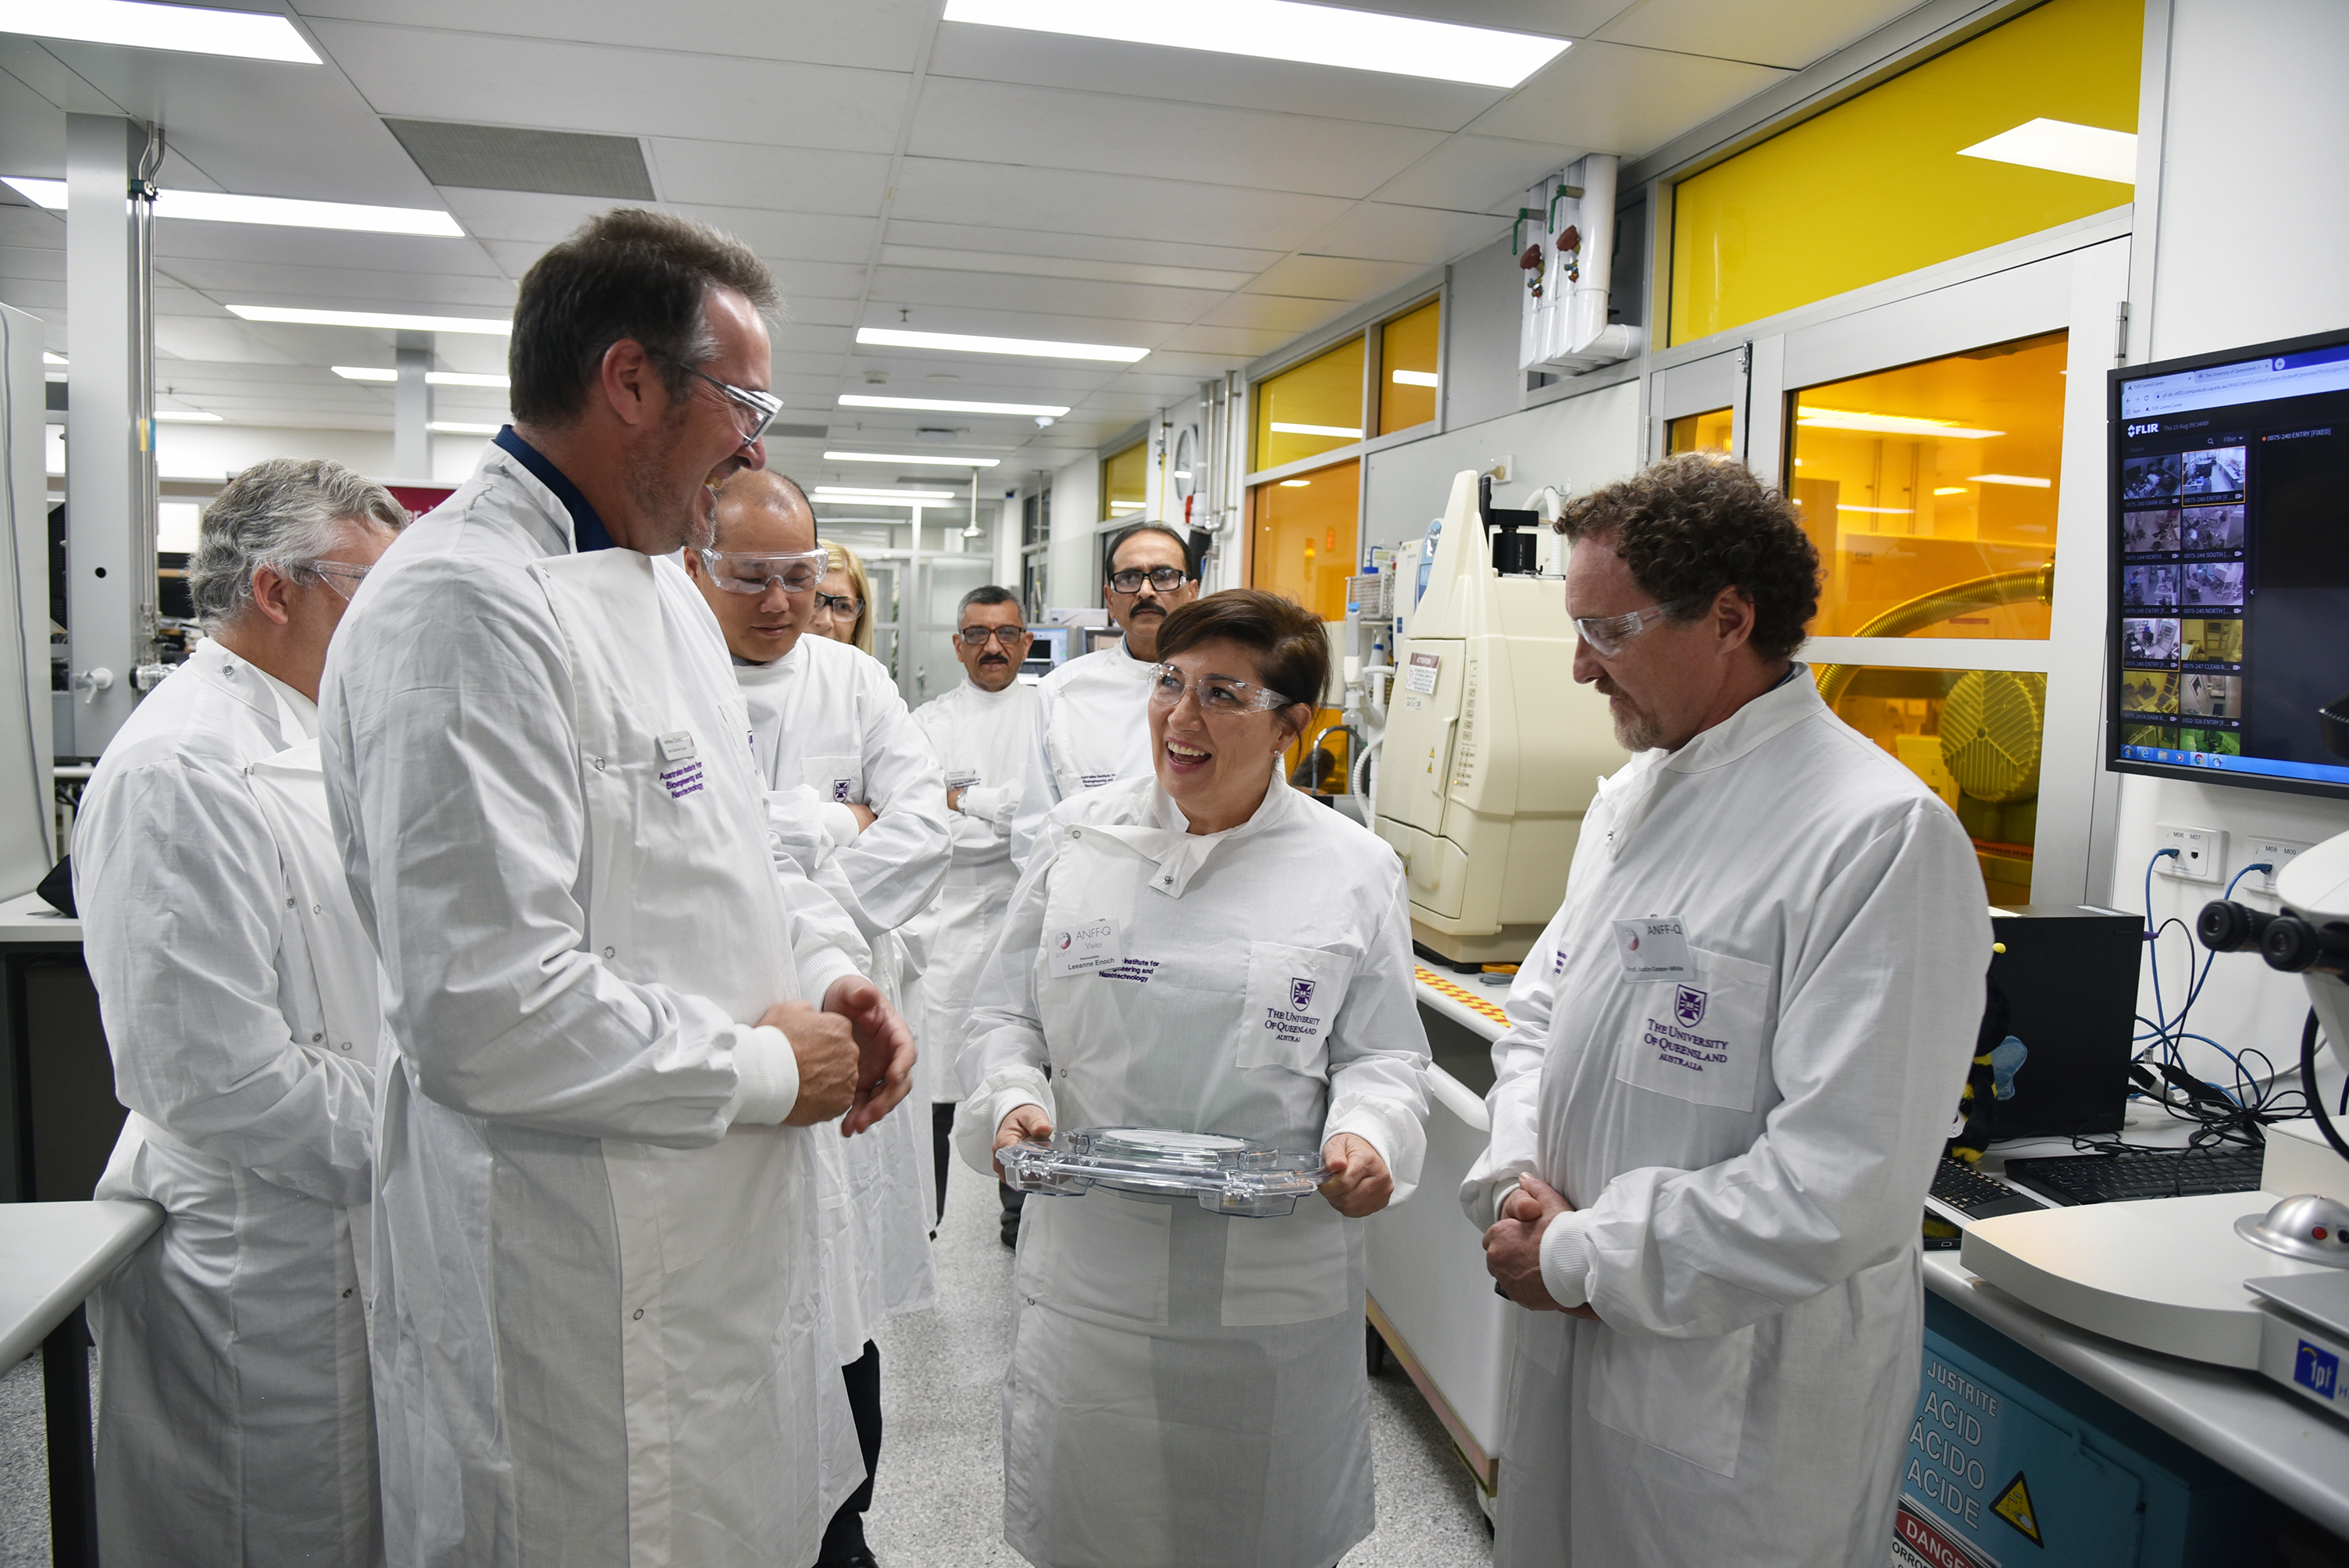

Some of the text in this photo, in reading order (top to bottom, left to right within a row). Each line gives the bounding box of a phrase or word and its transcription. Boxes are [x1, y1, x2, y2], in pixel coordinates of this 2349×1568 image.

[2135, 422, 2159, 435] FLIR
[2291, 430, 2311, 439] ENTRY
[2311, 428, 2331, 437] [FIXED]
[1075, 925, 1111, 941] ANFF-Q
[1648, 924, 1683, 935] ANFF-Q
[1055, 950, 1072, 958] ANFF
[1124, 957, 1149, 966] Institute
[1068, 957, 1115, 971] Leeanne Enoch
[1099, 971, 1149, 982] Nanotechnology
[1267, 1007, 1321, 1025] THE UNIVERSITY
[1264, 1020, 1277, 1030] OF
[1648, 1018, 1729, 1049] THE UNIVERSITY
[1644, 1033, 1727, 1064] OF QUEENSLAND
[1659, 1053, 1703, 1071] AUSTRALIA
[1927, 1360, 1998, 1418] JUSTRITE
[1923, 1389, 1983, 1446] ACID
[1908, 1415, 1986, 1491] ÁCIDO
[1905, 1457, 1981, 1531] ACIDE
[1906, 1519, 1969, 1568] DANGE
